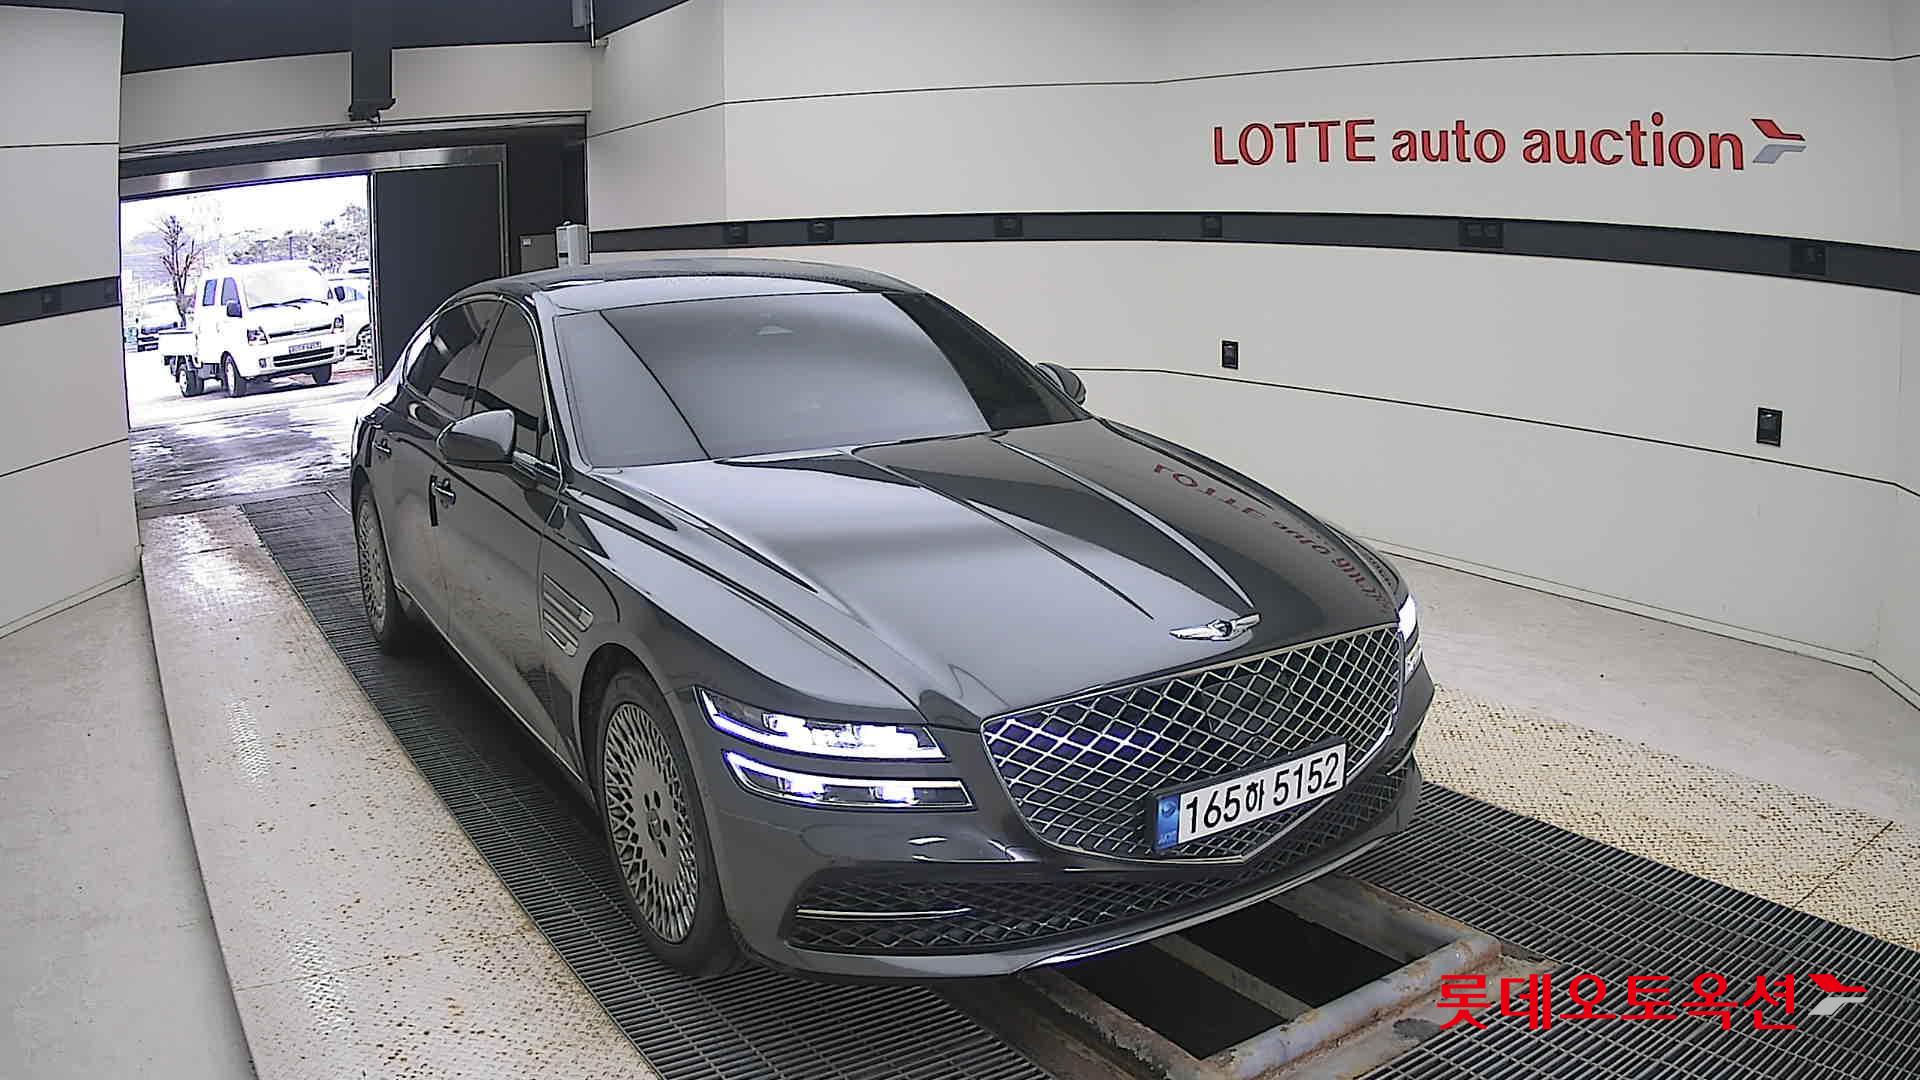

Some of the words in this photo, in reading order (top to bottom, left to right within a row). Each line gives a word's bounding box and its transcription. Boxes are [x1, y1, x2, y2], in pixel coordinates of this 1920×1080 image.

[1213, 118, 1377, 166] LOTTE
[1391, 119, 1507, 163] auto
[1522, 111, 1745, 171] auction
[1186, 778, 1265, 834] 165하
[1273, 752, 1340, 806] 5152
